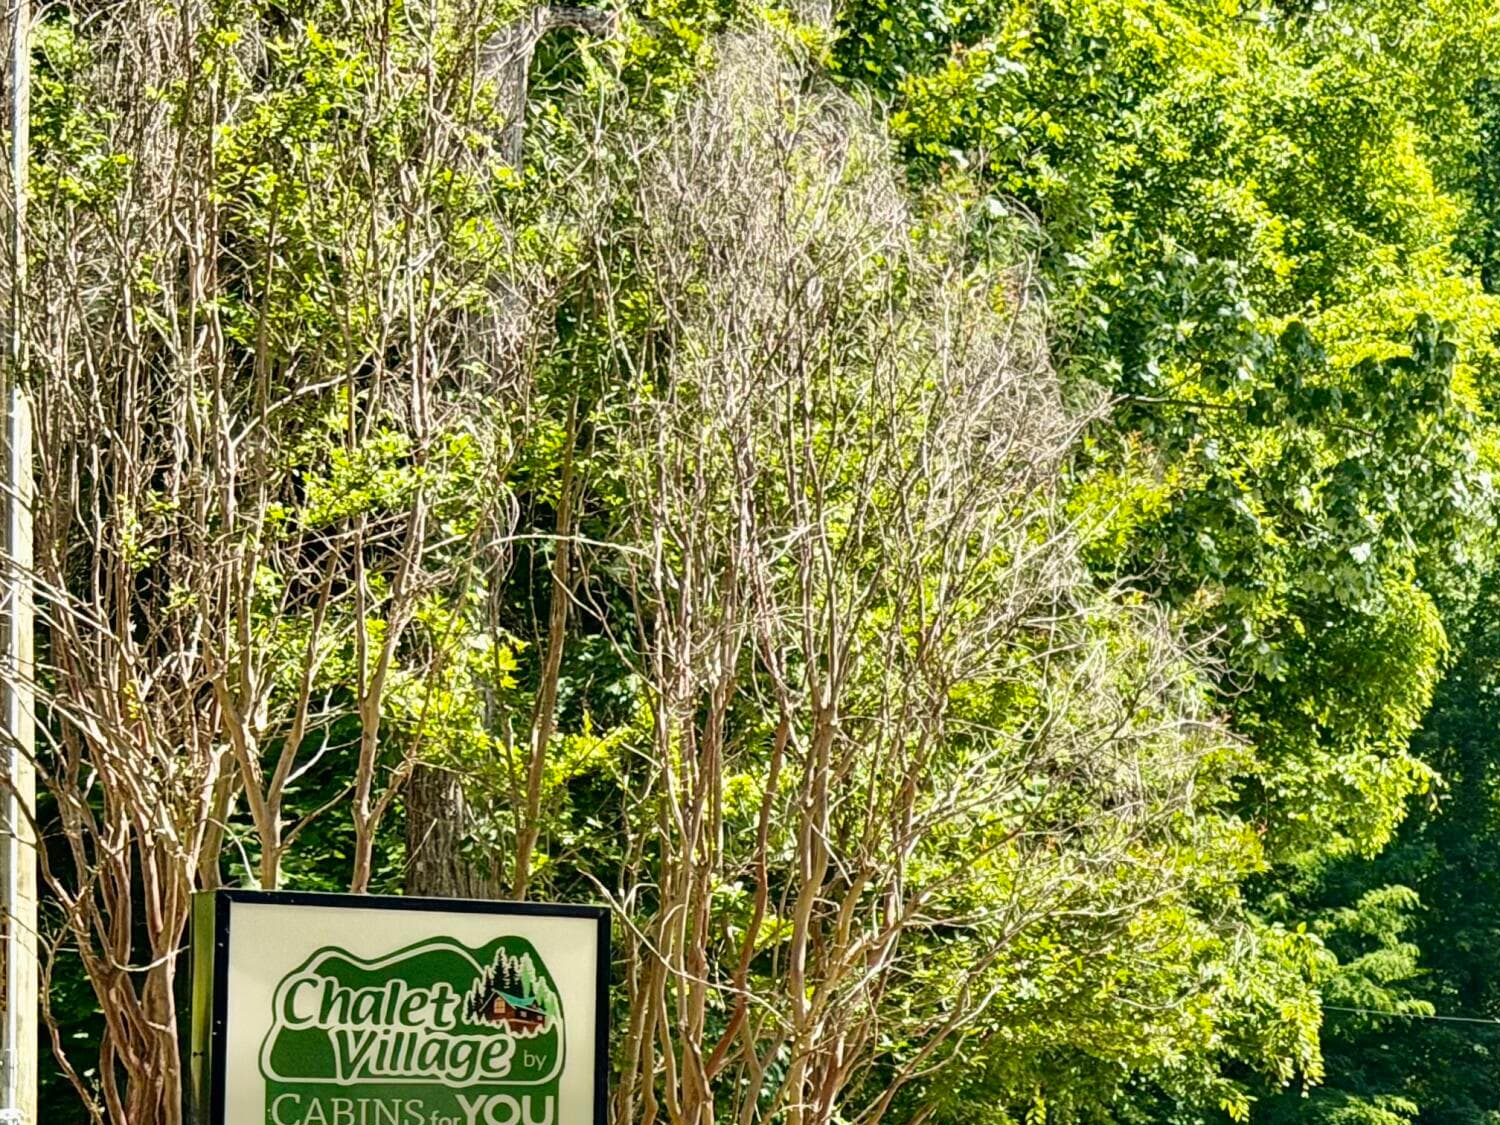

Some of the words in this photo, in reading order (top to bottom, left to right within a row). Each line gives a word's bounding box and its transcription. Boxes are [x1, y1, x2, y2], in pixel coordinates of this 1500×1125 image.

[283, 977, 461, 1028] Chalet
[336, 1028, 510, 1082] Village
[523, 1049, 547, 1069] by
